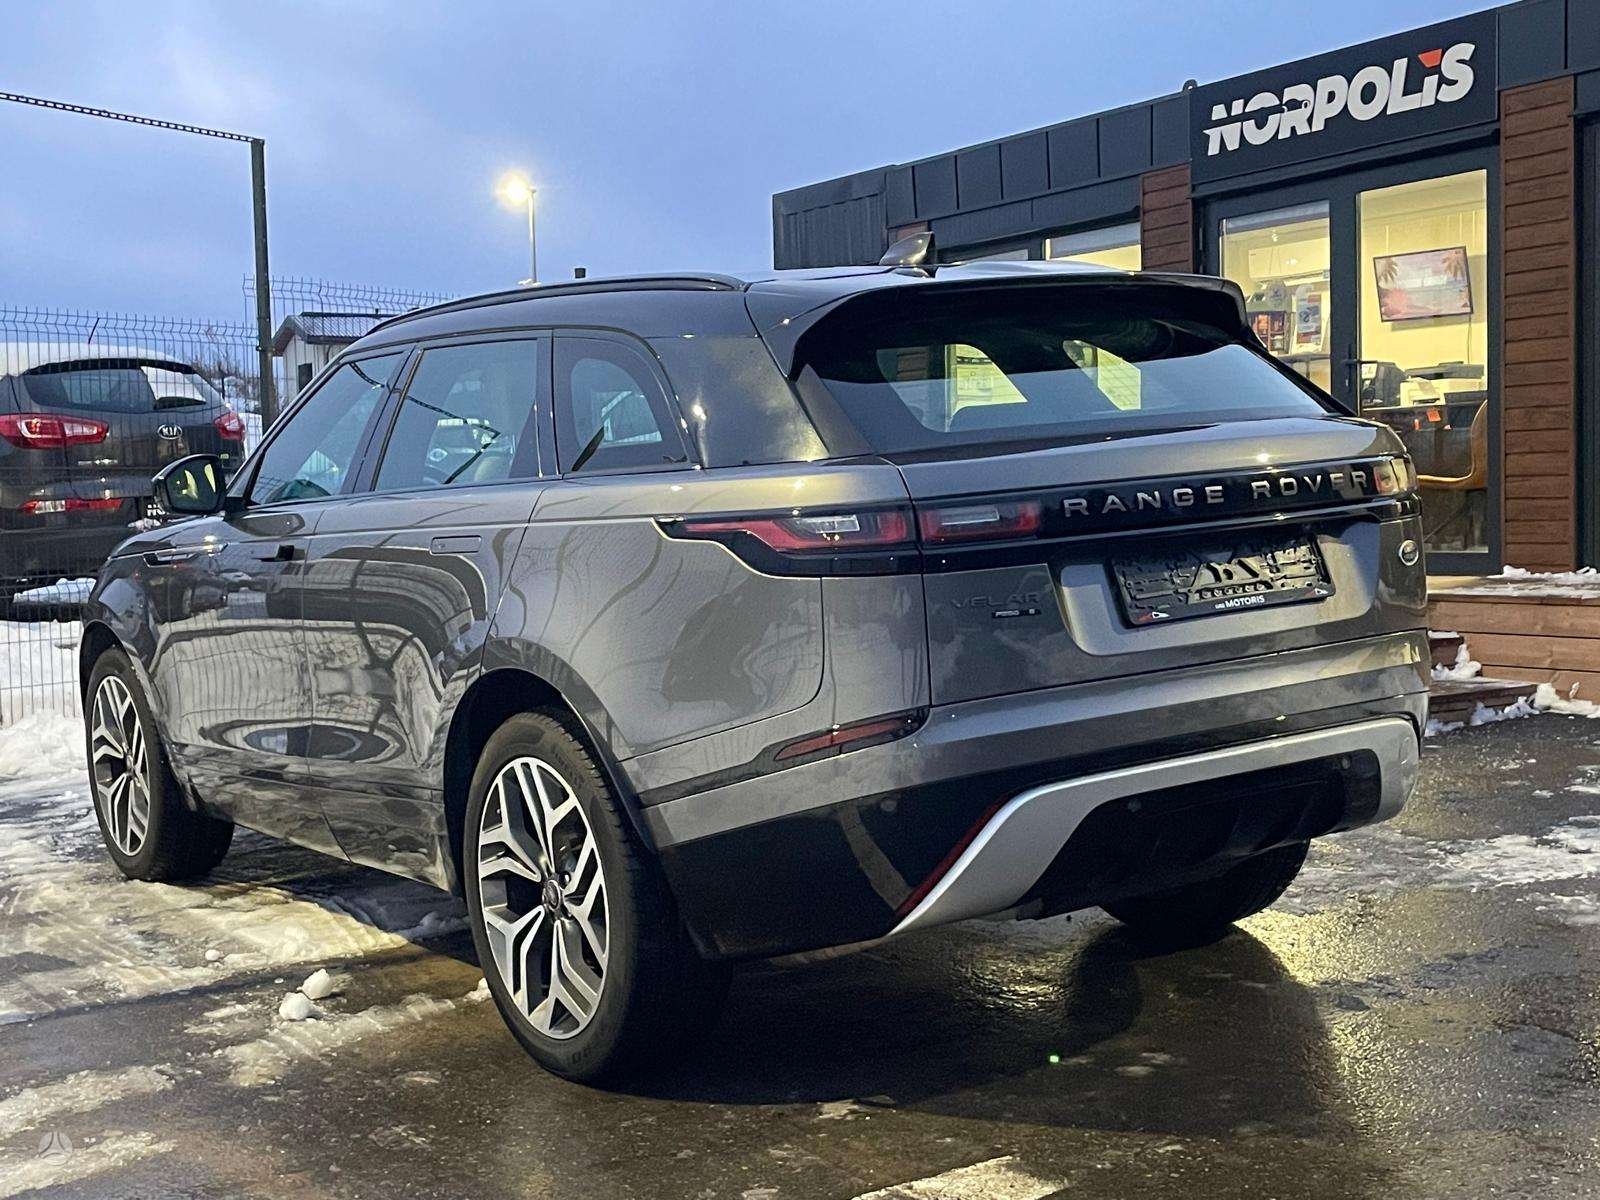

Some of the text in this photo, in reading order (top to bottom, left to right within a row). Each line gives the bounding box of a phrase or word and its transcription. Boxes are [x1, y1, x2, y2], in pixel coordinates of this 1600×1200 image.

[1063, 470, 1368, 518] RANGE ROVER
[952, 591, 1040, 608] VELAR
